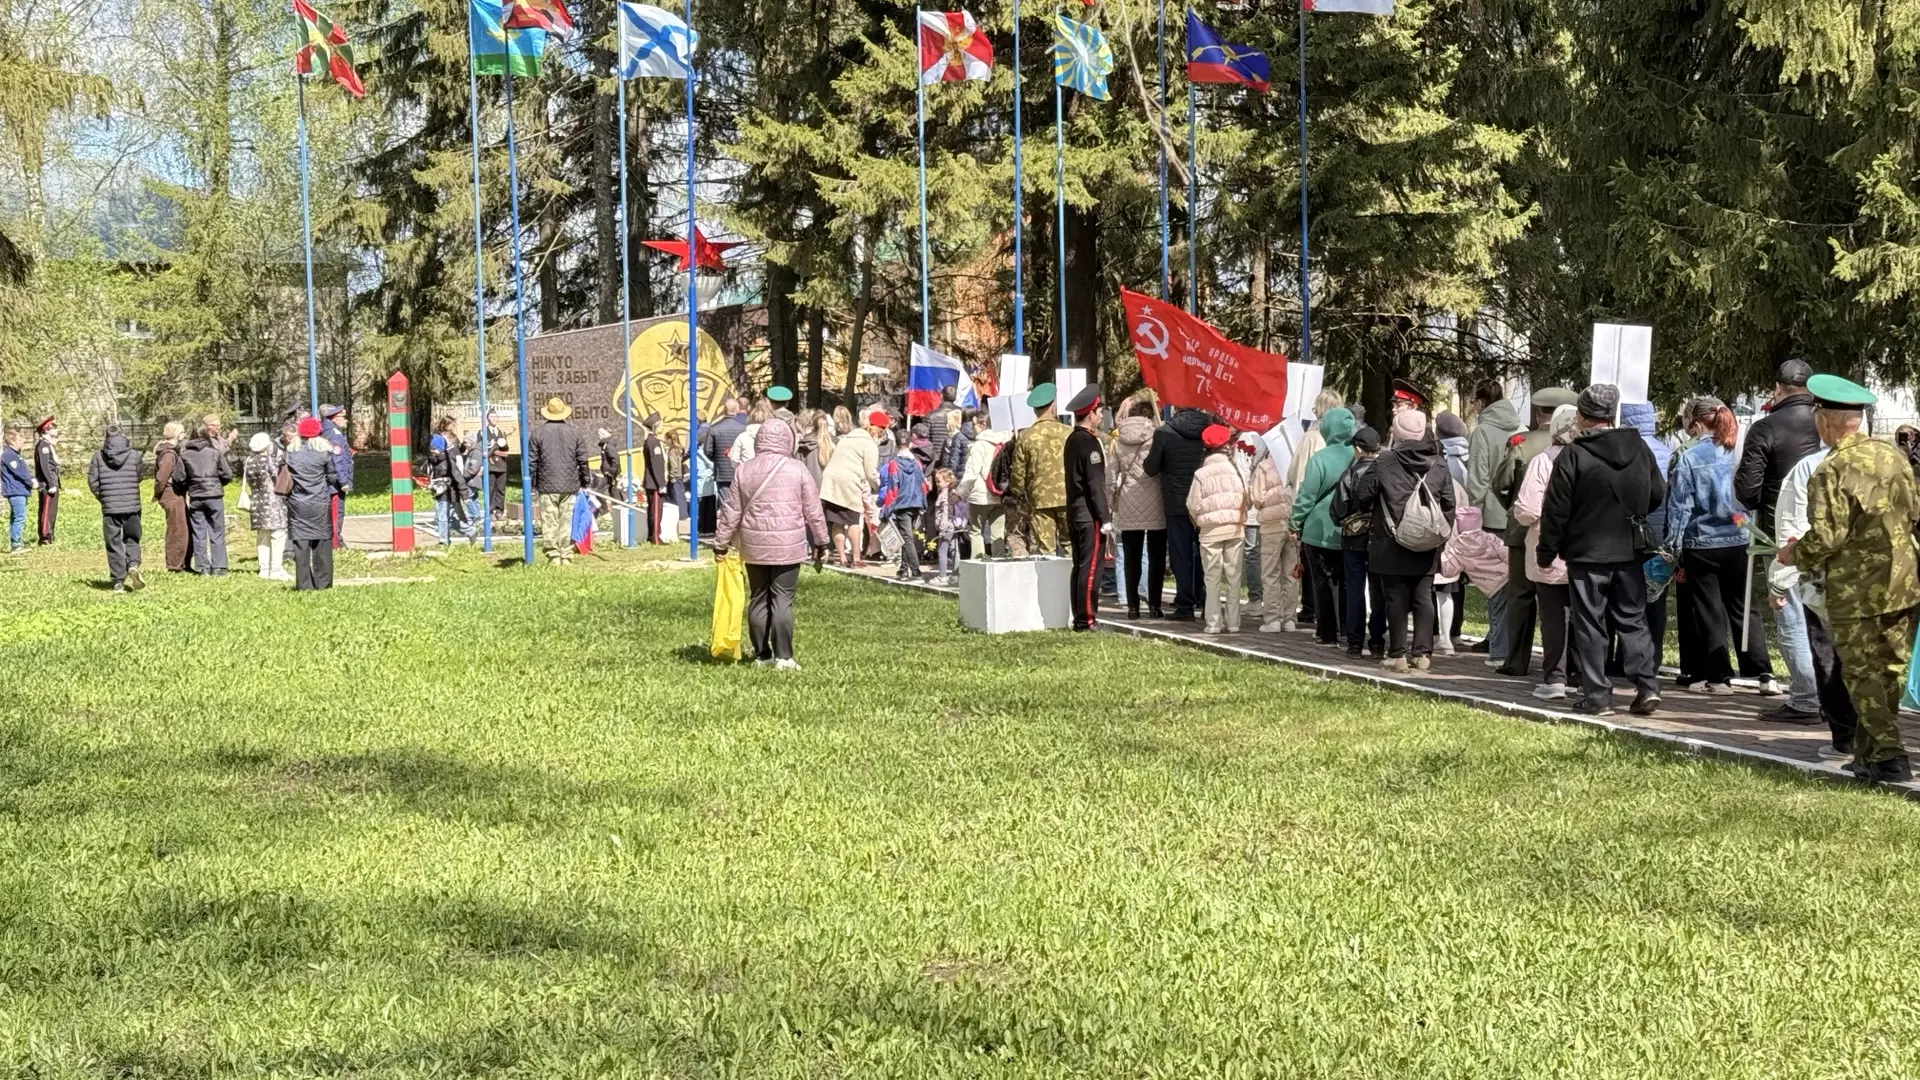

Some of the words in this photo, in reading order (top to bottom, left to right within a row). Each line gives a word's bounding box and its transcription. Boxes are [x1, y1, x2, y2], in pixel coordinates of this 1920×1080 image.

[532, 356, 573, 369] НИКТО
[533, 371, 548, 385] НЕ
[556, 370, 599, 384] ЗАБЫТ
